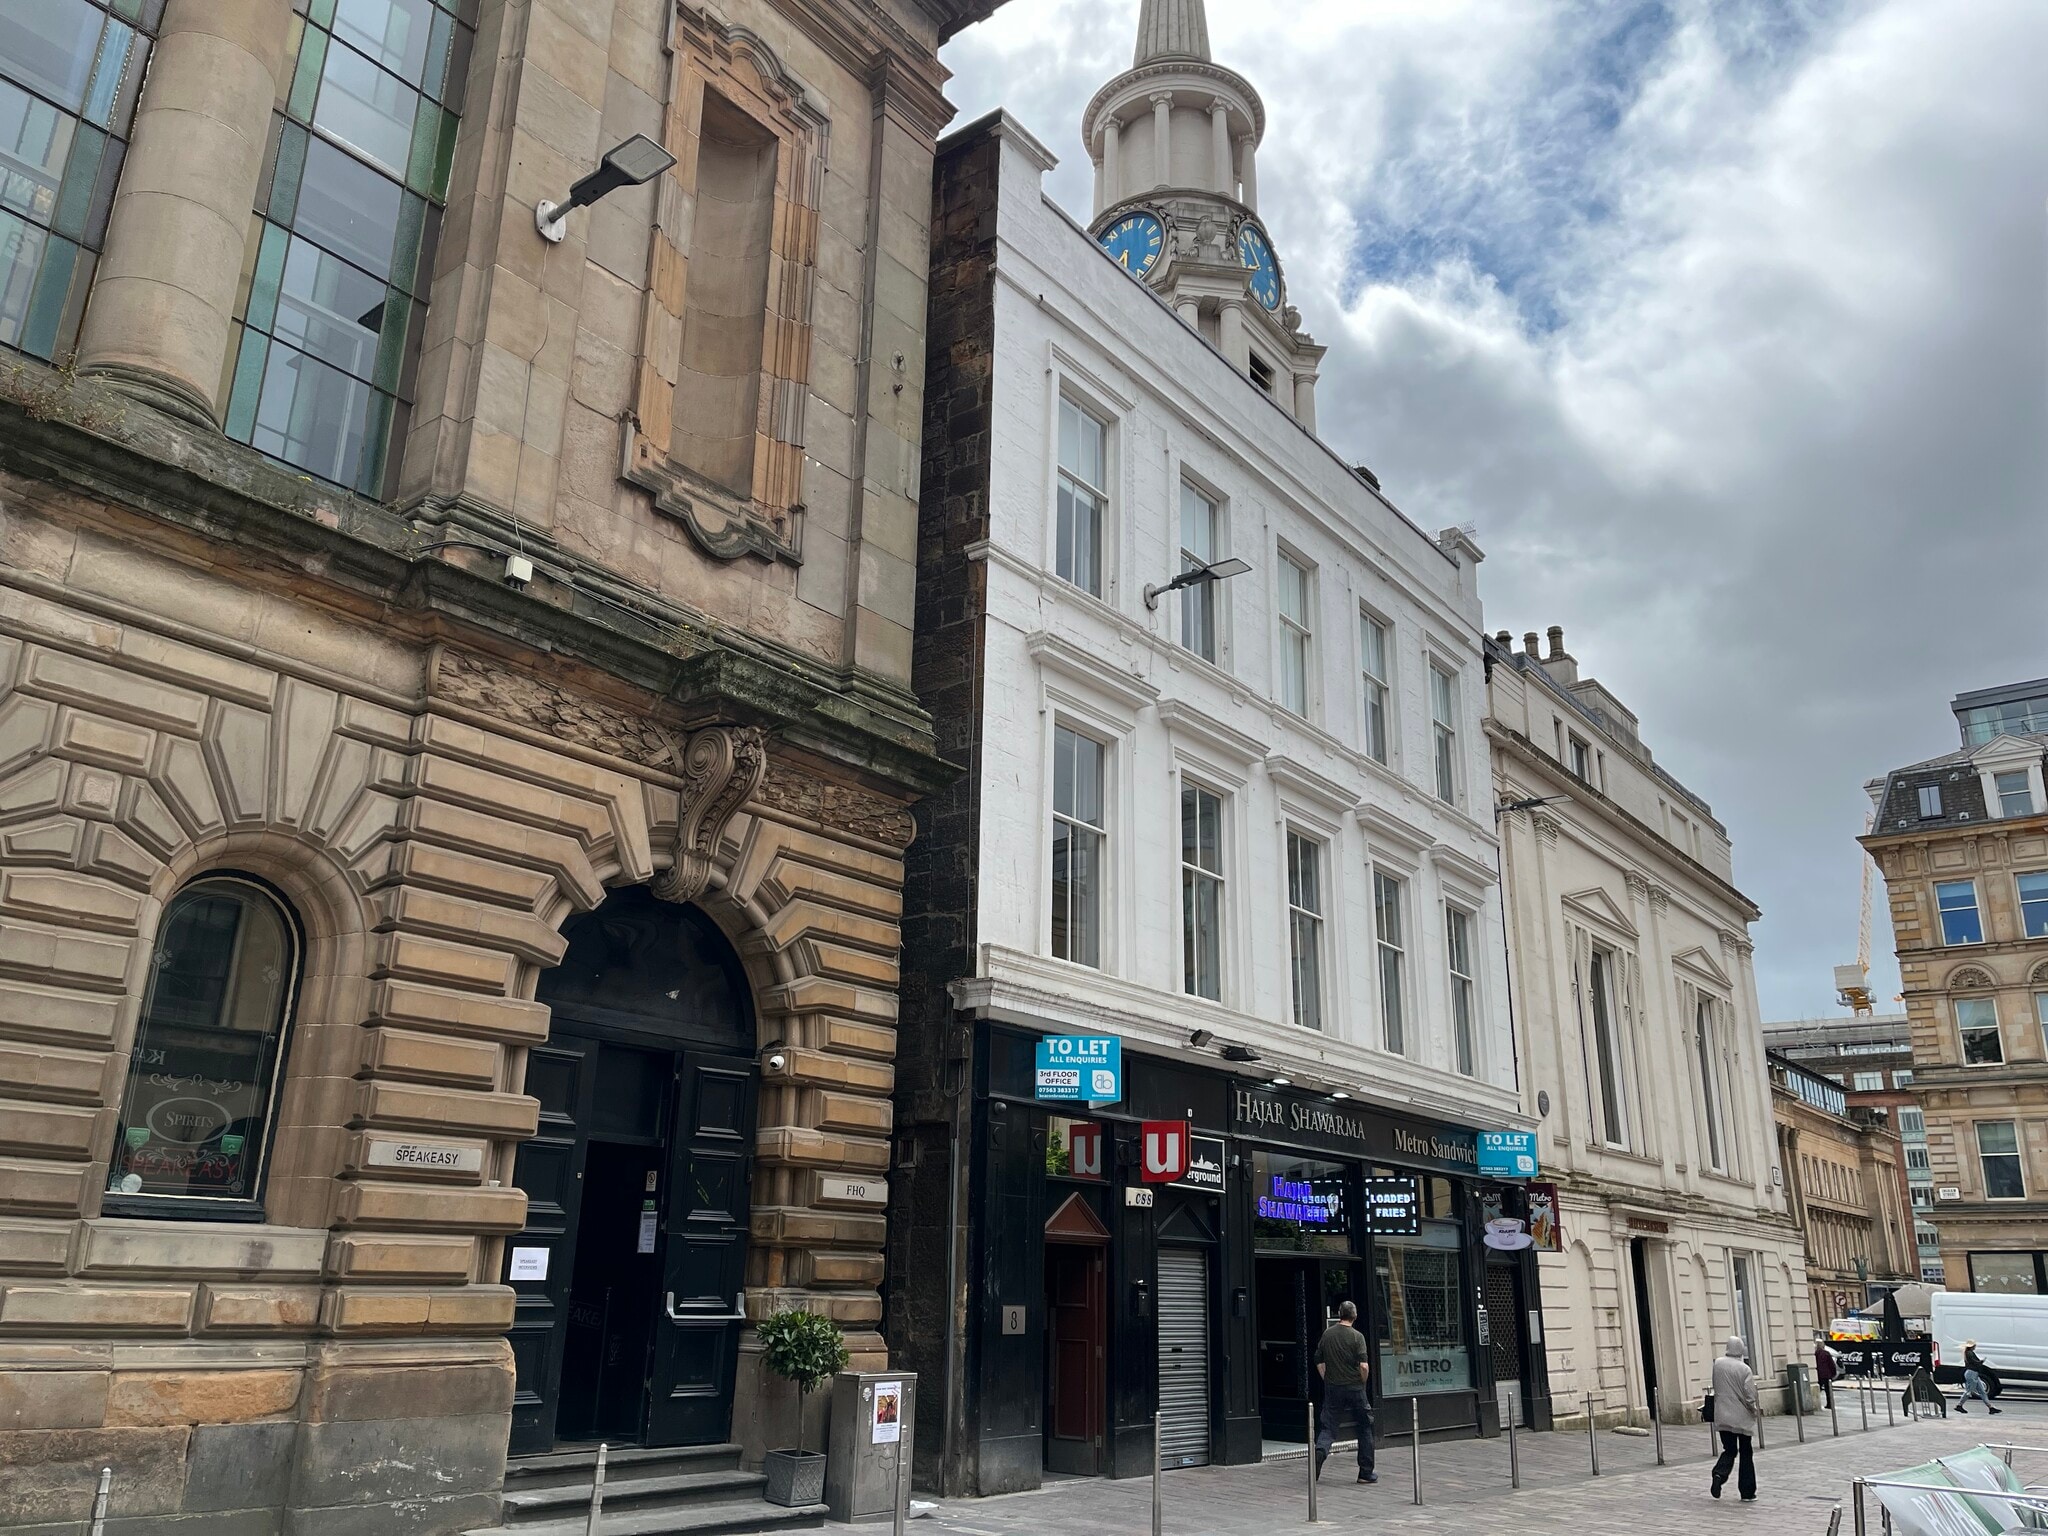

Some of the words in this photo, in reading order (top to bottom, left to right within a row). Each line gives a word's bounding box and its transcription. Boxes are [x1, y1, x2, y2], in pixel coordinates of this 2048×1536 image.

[1047, 1039, 1072, 1054] TO
[1079, 1040, 1110, 1055] LET
[1066, 1056, 1107, 1064] ENQUIRIES
[164, 1111, 214, 1128] SPIRITS
[1236, 1090, 1284, 1128] HAJAR
[1290, 1102, 1365, 1140] SHAWARMA
[1394, 1128, 1429, 1156] Metro
[1431, 1135, 1477, 1165] Sandwich
[1484, 1134, 1502, 1145] TO
[1506, 1135, 1529, 1146] LET
[395, 1149, 459, 1165] SPEAKEASY
[1187, 1170, 1221, 1183] erground
[846, 1184, 866, 1197] FHQ
[1530, 1193, 1552, 1201] Metro
[1370, 1194, 1411, 1204] LOADED
[1376, 1208, 1406, 1218] FRIES
[1010, 1300, 1018, 1330] 8
[1891, 1352, 1921, 1363] Coca-Cola
[1398, 1359, 1452, 1375] METRO
